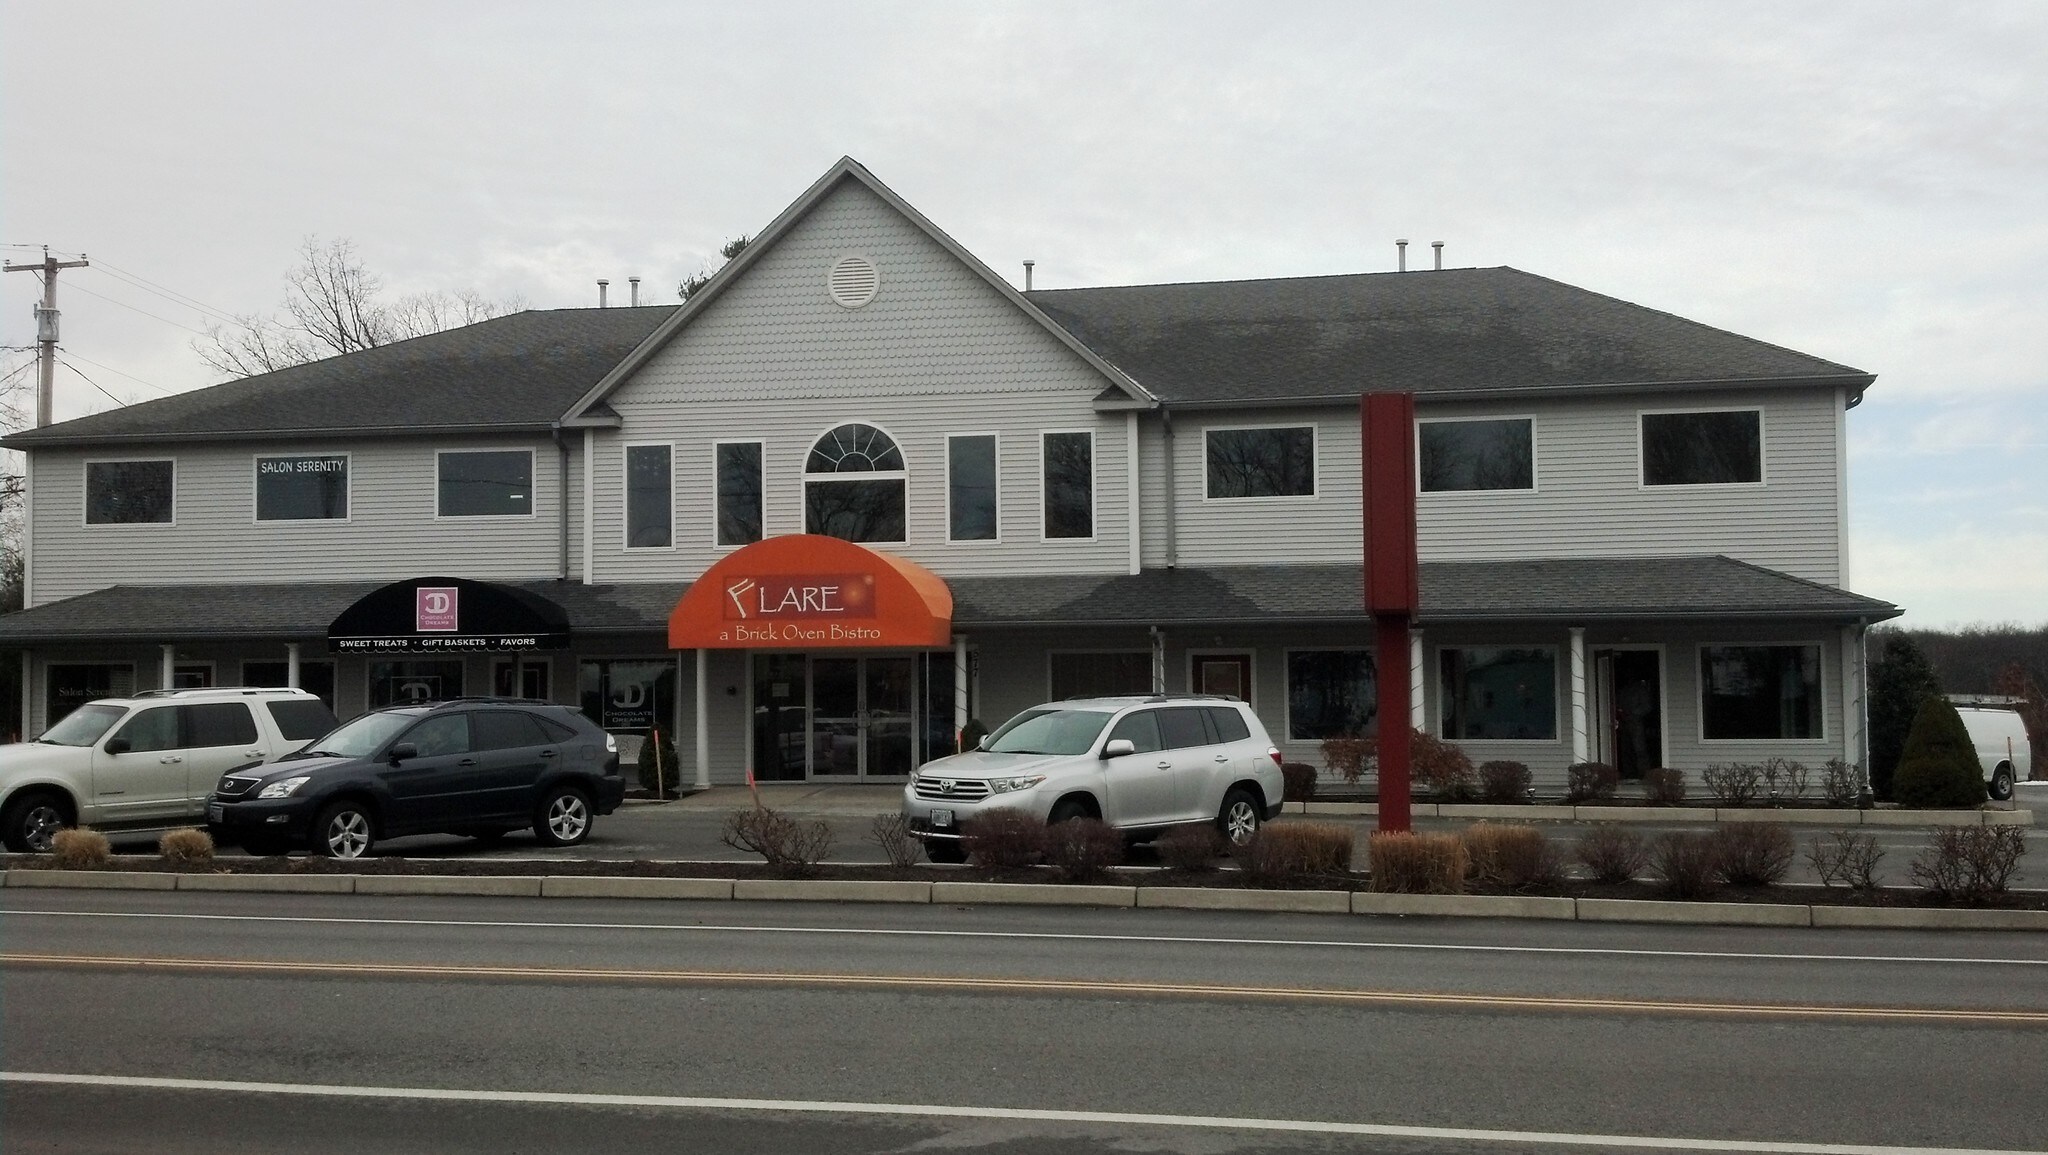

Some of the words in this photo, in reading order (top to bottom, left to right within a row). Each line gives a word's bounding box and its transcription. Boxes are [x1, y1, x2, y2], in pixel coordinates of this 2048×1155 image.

[261, 461, 293, 473] SALON
[296, 460, 344, 472] SERENITY
[719, 631, 729, 641] a
[735, 622, 778, 641] Brick
[782, 624, 826, 640] Oven
[830, 623, 881, 640] Bistro
[339, 640, 371, 648] SWEET
[373, 639, 408, 647] TREATS
[421, 638, 443, 647] GIFT
[444, 638, 487, 646] BASKETS
[500, 637, 536, 646] FAVORS
[58, 687, 83, 697] Salon
[604, 710, 653, 718] CHOCOLATE
